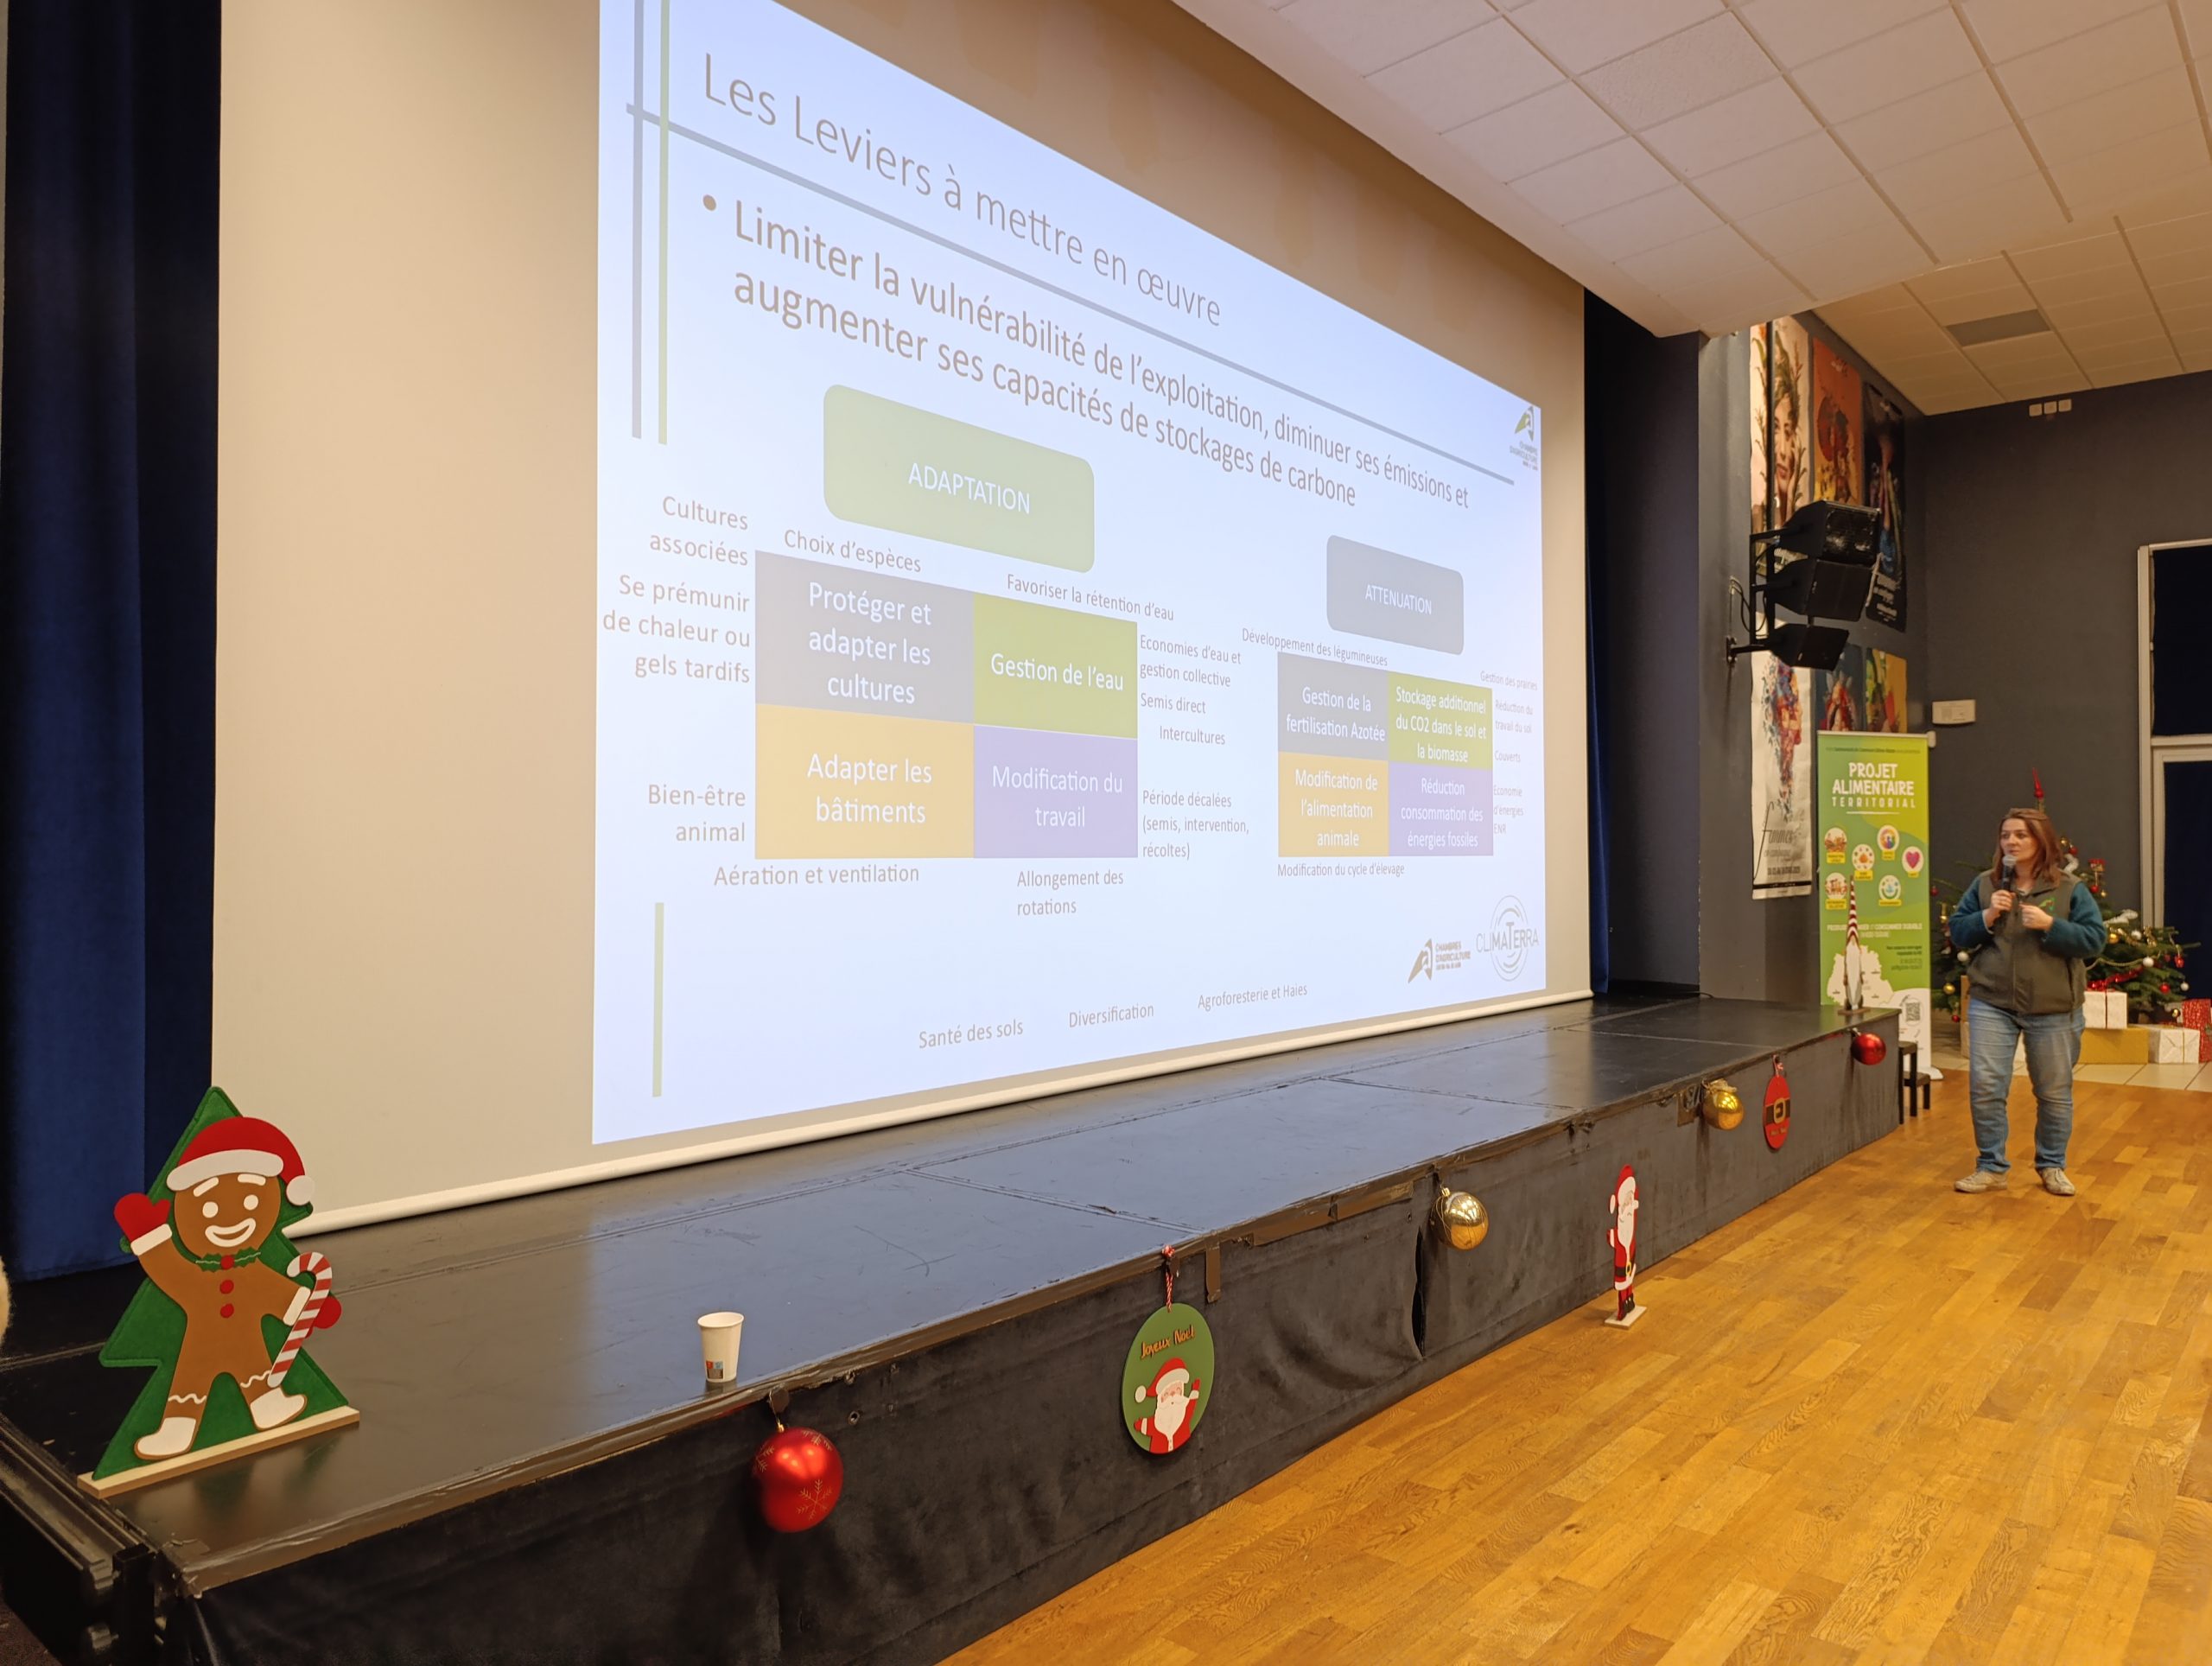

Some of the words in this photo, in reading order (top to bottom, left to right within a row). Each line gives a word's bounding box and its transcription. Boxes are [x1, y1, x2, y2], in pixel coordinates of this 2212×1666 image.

[706, 53, 776, 125] Les
[796, 95, 931, 195] Leviers
[944, 164, 961, 211] à
[977, 191, 1083, 264] mettre
[1094, 248, 1126, 285] en
[1138, 269, 1220, 326] œuvre
[736, 200, 862, 281] Limiter
[875, 251, 899, 296] la
[911, 277, 1085, 366] vulnérabilité
[1095, 343, 1122, 380] de
[1275, 413, 1351, 464] diminuer
[1356, 449, 1379, 475] ses
[1384, 455, 1452, 502] émissions
[1456, 487, 1468, 508] et
[734, 272, 928, 361] augmenter
[938, 343, 983, 382] ses
[993, 364, 1113, 425] capacités
[1121, 402, 1148, 437] de
[1155, 419, 1254, 473] stockages
[1261, 451, 1281, 482] de
[1288, 467, 1356, 506] carbone
[908, 462, 1030, 514] ADAPTATION
[663, 496, 748, 531] Cultures
[649, 534, 748, 566] associées
[784, 529, 835, 556] Choix
[620, 575, 645, 596] Se
[653, 582, 750, 612] prémunir
[809, 582, 905, 622] Protéger
[912, 603, 931, 626] et
[1007, 574, 1067, 601] Favoriser
[1071, 587, 1082, 602] la
[1086, 589, 1141, 614] rétention
[1365, 584, 1432, 615] ATTENUATION
[603, 610, 630, 633] de
[639, 614, 719, 643] chaleur
[725, 629, 750, 647] ou
[809, 627, 897, 661] adapter
[903, 639, 931, 665] les
[1141, 634, 1198, 658] Economies
[1231, 652, 1241, 664] et
[1243, 627, 1314, 653] Développement
[1317, 642, 1332, 657] des
[1333, 645, 1388, 666] légumineuses
[635, 654, 677, 678] gels
[685, 658, 750, 684] tardifs
[991, 652, 1058, 682] Gestion
[1063, 663, 1083, 685] de
[1140, 664, 1179, 680] gestion
[1183, 669, 1230, 687] collective
[827, 673, 915, 704] cultures
[1302, 686, 1344, 709] Gestion
[1347, 694, 1359, 710] de
[1363, 695, 1371, 712] la
[1395, 686, 1436, 709] Stockage
[1439, 695, 1486, 715] additionnel
[1141, 692, 1173, 710] Semis
[1176, 696, 1206, 715] direct
[1160, 725, 1225, 745] Intercultures
[1287, 714, 1348, 737] fertilisation
[1351, 721, 1385, 741] Azotée
[1395, 714, 1408, 730] du
[1410, 715, 1430, 733] CO2
[1432, 719, 1452, 735] dans
[1454, 722, 1462, 736] le
[1465, 722, 1476, 738] sol
[1478, 726, 1486, 740] et
[1417, 743, 1425, 759] la
[1427, 744, 1468, 762] biomasse
[807, 753, 898, 785] Adapter
[905, 759, 931, 784] les
[993, 765, 1098, 792] Modification
[1103, 772, 1122, 793] du
[1295, 769, 1362, 790] Modification
[1365, 774, 1378, 791] de
[1848, 762, 1897, 778] PROJET
[648, 784, 747, 807] Bien-être
[1142, 788, 1185, 805] Période
[1188, 792, 1231, 807] décalées
[1421, 777, 1465, 796] Réduction
[1832, 779, 1914, 796] ALIMENTAIRE
[816, 796, 926, 823] bâtiments
[1401, 807, 1466, 820] consommation
[1469, 805, 1483, 822] des
[1832, 797, 1916, 808] TERRITORIAL
[1035, 805, 1085, 827] travail
[1142, 815, 1180, 835] (semis,
[1185, 817, 1249, 835] intervention,
[676, 822, 746, 842] animal
[1317, 830, 1359, 847] animale
[1408, 831, 1446, 850] énergies
[1447, 831, 1478, 847] fossiles
[1142, 842, 1190, 861] récoltes)
[714, 864, 798, 887] Aération
[804, 868, 823, 884] et
[829, 863, 919, 883] ventilation
[1017, 870, 1100, 890] Allongement
[1103, 868, 1124, 886] des
[1277, 863, 1332, 877] Modification
[1335, 863, 1345, 876] du
[1347, 862, 1367, 877] cycle
[1017, 898, 1077, 916] rotations
[1198, 990, 1268, 1012] Agroforesterie
[1271, 986, 1280, 999] et
[1283, 982, 1307, 998] Haies
[1069, 1003, 1154, 1028] Diversification
[919, 1025, 962, 1049] Santé
[967, 1024, 992, 1042] des
[997, 1019, 1023, 1038] sols
[1141, 1338, 1171, 1358] Joyeux
